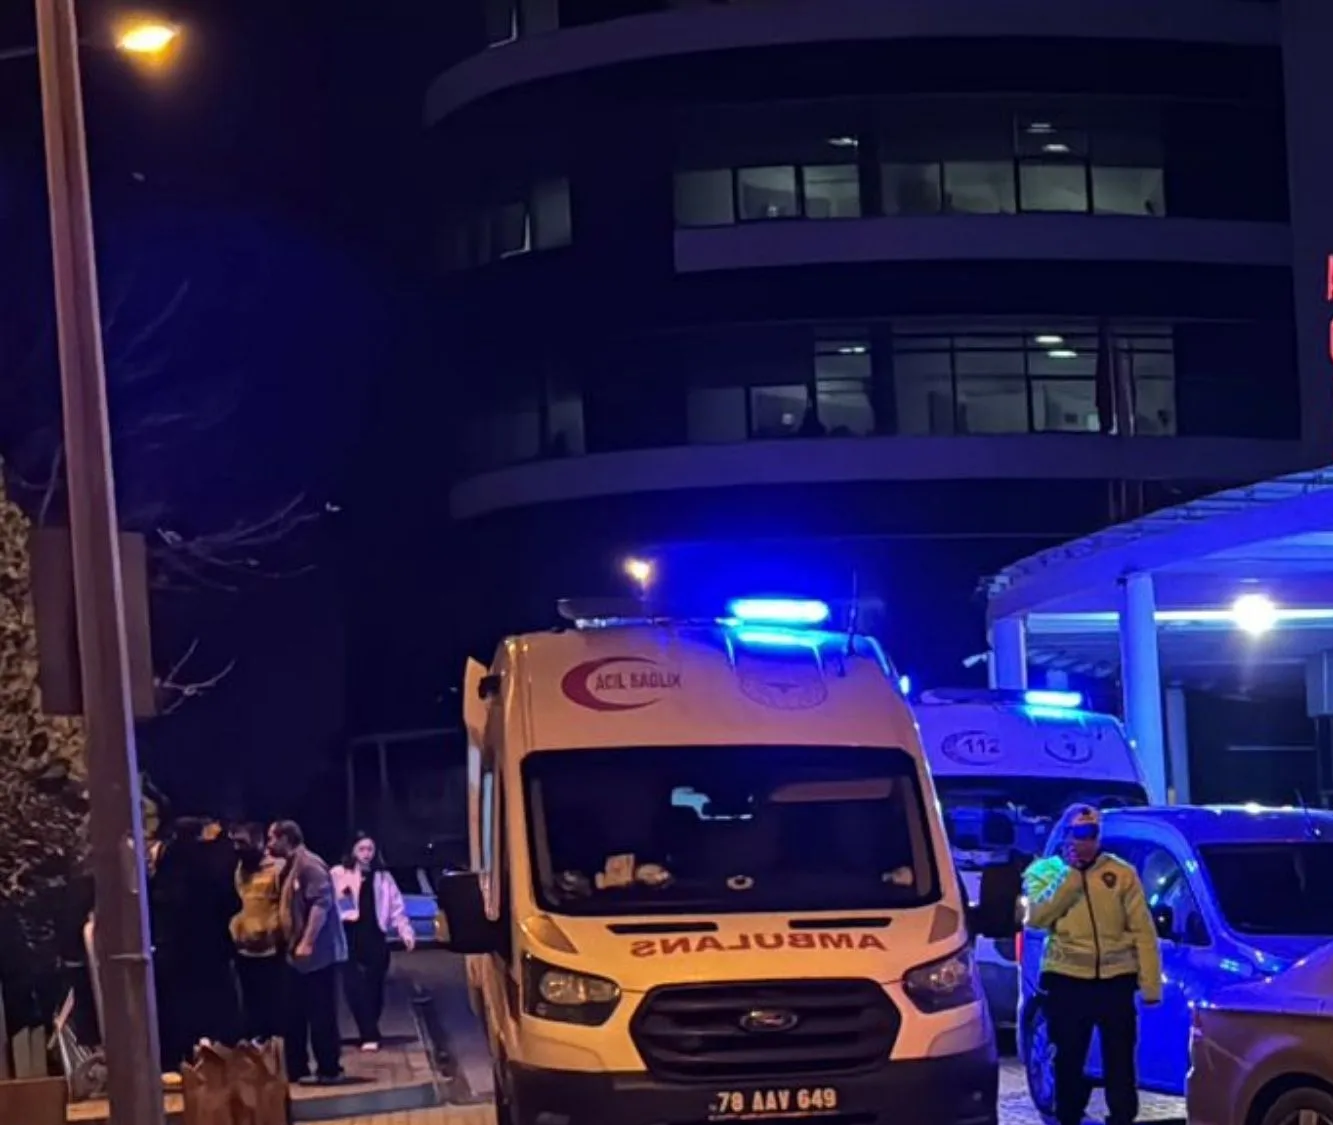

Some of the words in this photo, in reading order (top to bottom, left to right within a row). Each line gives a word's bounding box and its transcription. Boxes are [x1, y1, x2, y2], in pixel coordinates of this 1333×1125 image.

[716, 1091, 744, 1112] 78
[752, 1089, 790, 1111] AAV
[797, 1087, 837, 1109] 649
